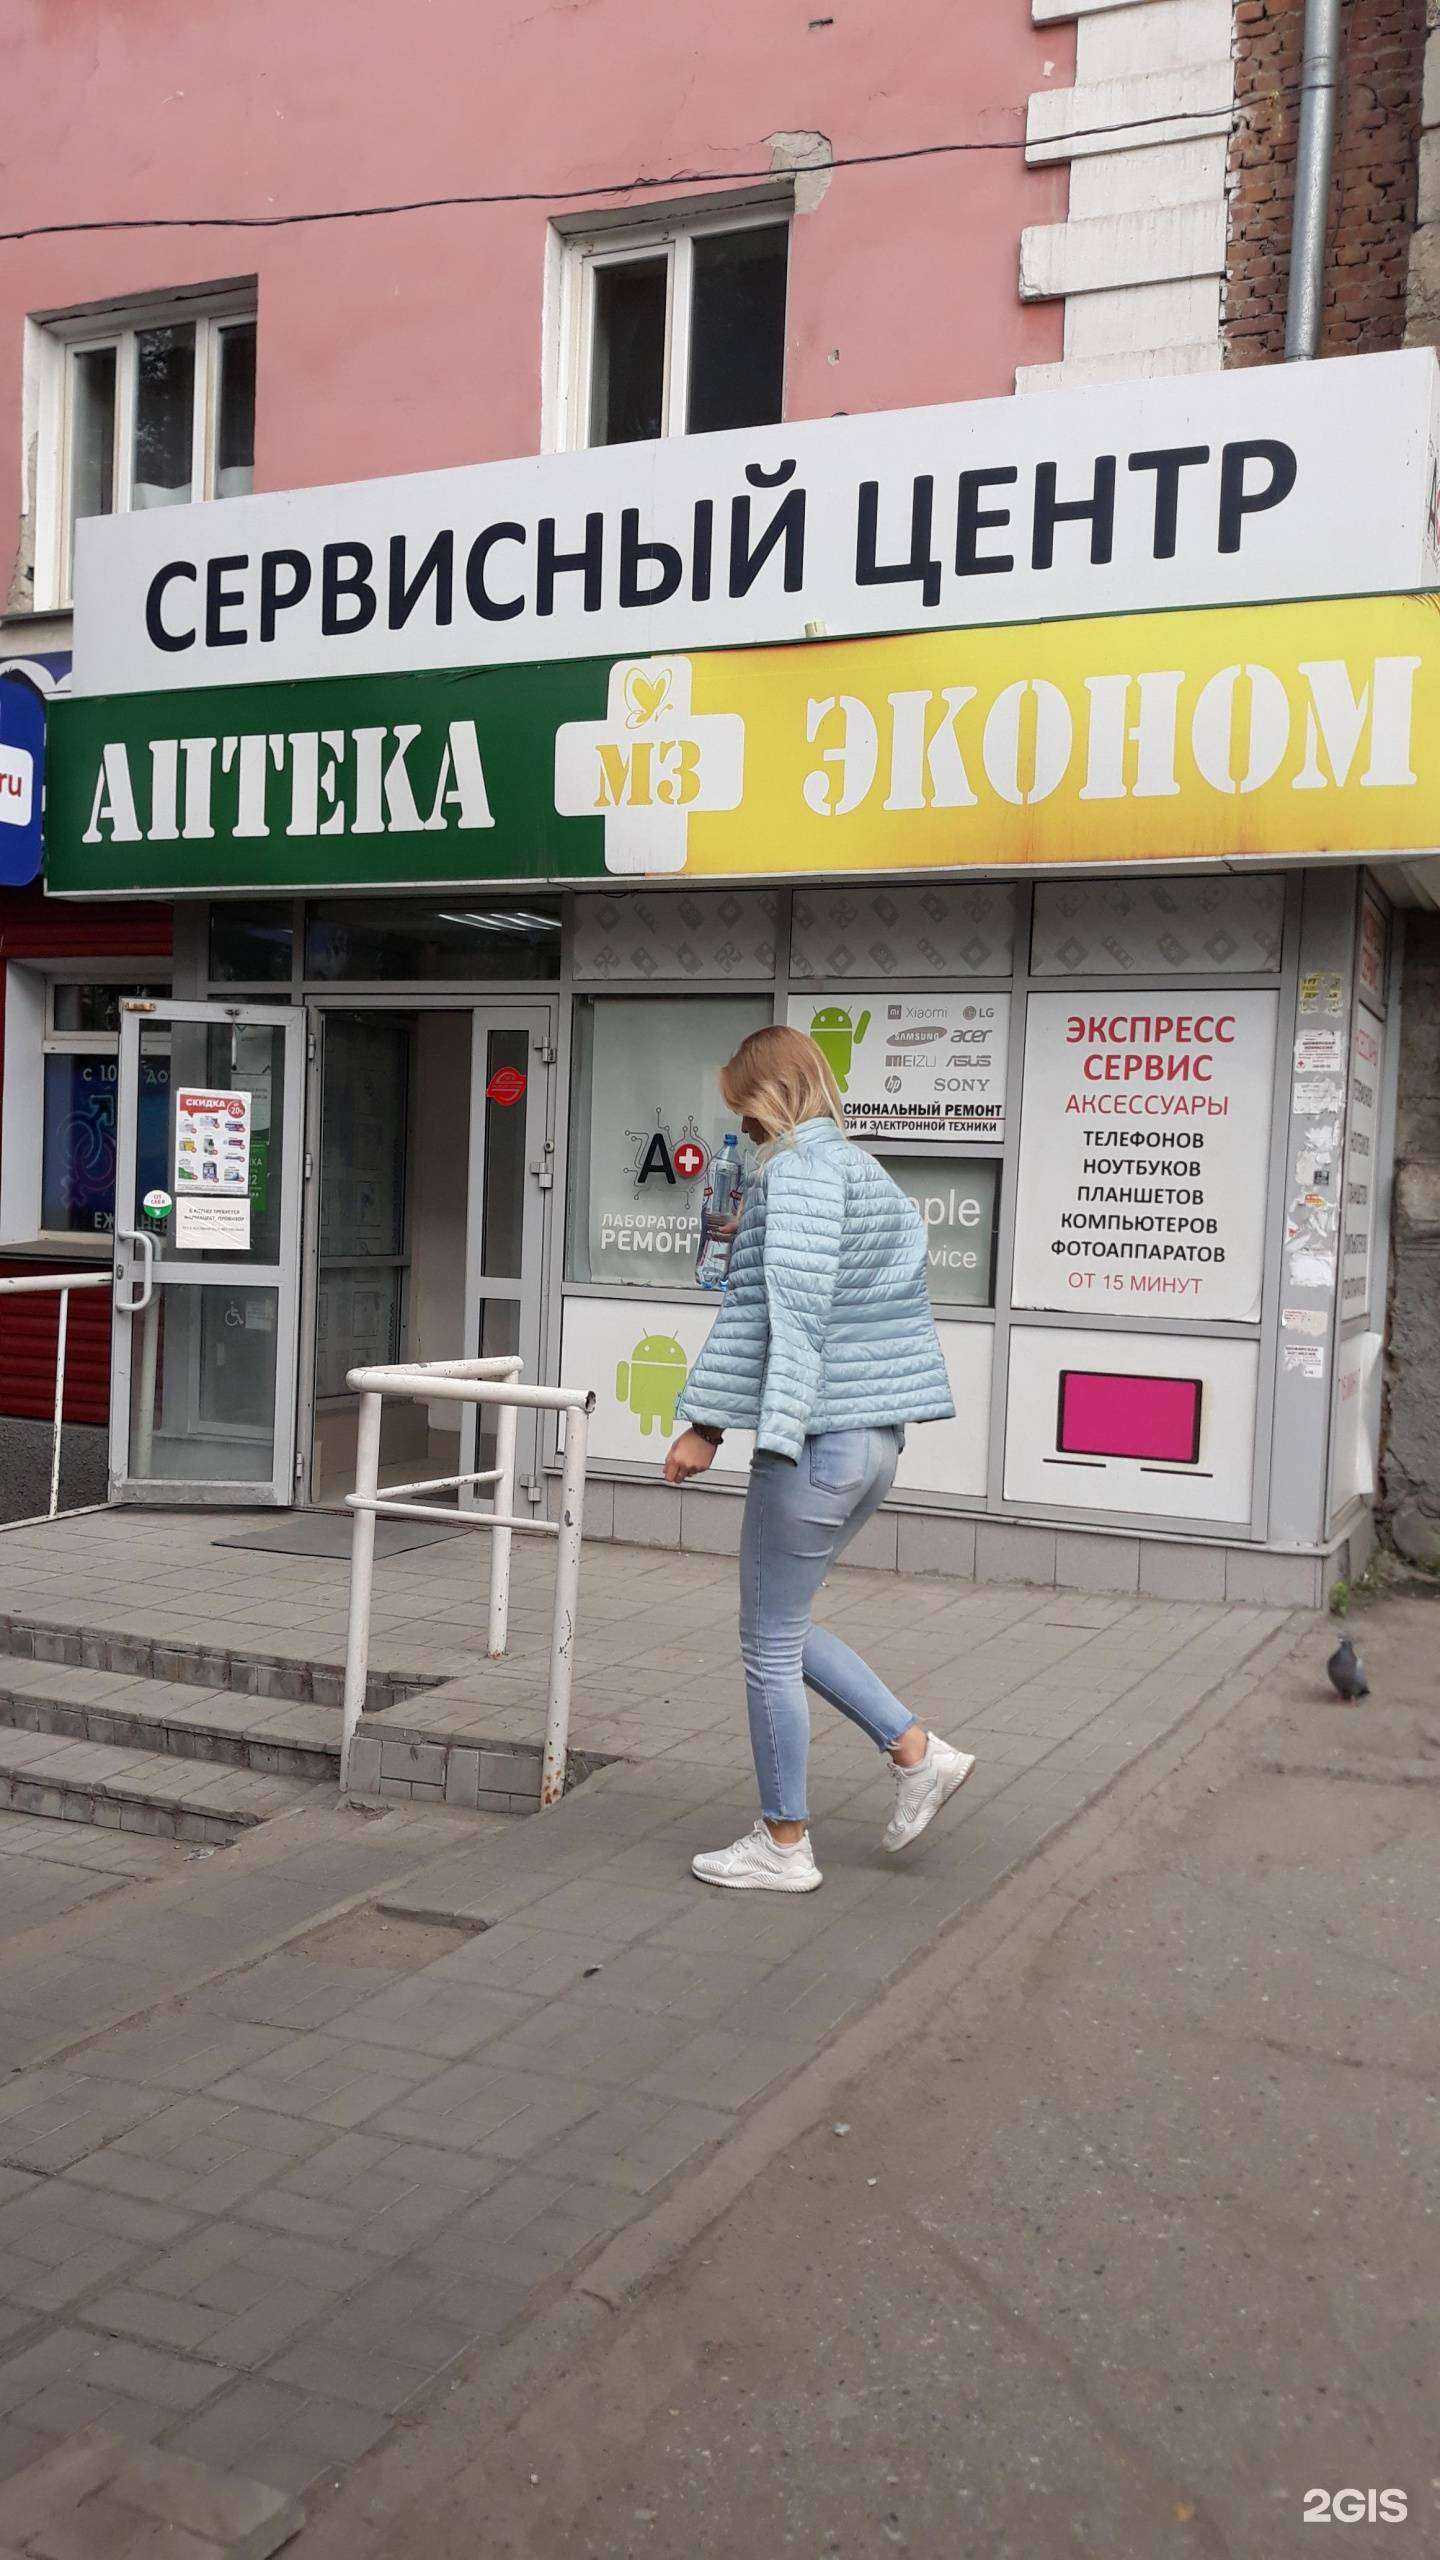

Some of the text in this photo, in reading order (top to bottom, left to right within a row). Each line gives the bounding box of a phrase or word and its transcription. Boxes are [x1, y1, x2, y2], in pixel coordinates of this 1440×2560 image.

[146, 439, 1298, 653] СЕРВИСНЫЙ ЦЕНТР
[802, 656, 1422, 817] ЭКОНОМ
[82, 720, 496, 844] АПТЕКА
[905, 1007, 948, 1019] Xiaomi
[979, 1008, 994, 1018] LG
[894, 1032, 939, 1041] SAMSUNG
[950, 1029, 993, 1043] acer
[1065, 1016, 1236, 1043] ЭКСПРЕСС
[885, 1055, 937, 1068] MEIZU
[945, 1055, 992, 1068] ASUS
[1083, 1054, 1214, 1082] СЕРВИС
[934, 1078, 990, 1092] SONY
[186, 1098, 226, 1108] СКИДКА
[945, 1105, 1002, 1117] РЕМОНТ
[1065, 1095, 1229, 1116] АКСЕССУАРЫ
[870, 1120, 946, 1132] ЭЛЕКТРОННОЙ
[950, 1121, 997, 1132] ТЕХНИКИ
[1083, 1131, 1205, 1149] ТЕЛЕФОНОВ
[1083, 1159, 1201, 1177] НОУТБУКОВ
[1077, 1187, 1204, 1205] ПЛАНШЕТОВ
[1061, 1213, 1218, 1234] КОМПЬЮТЕРОВ
[1051, 1240, 1226, 1263] ФОТОАППАРАТОВ
[1068, 1272, 1203, 1295] ОТ 15 МИНУТ
